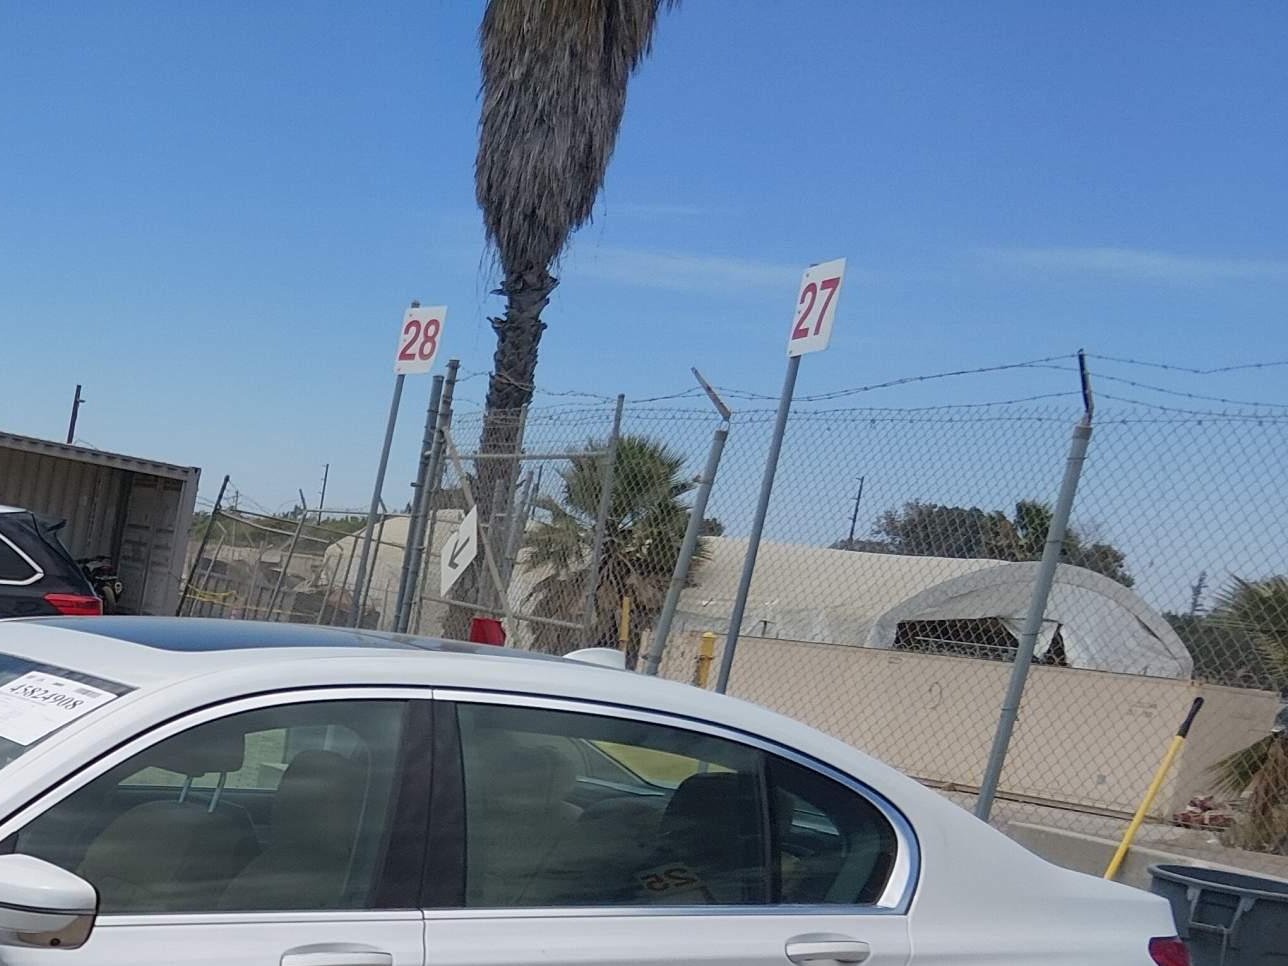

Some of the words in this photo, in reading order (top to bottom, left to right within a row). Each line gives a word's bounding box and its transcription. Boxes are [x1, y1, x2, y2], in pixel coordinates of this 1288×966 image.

[790, 276, 842, 341] 27
[397, 318, 441, 362] 28
[9, 682, 85, 711] 45824908
